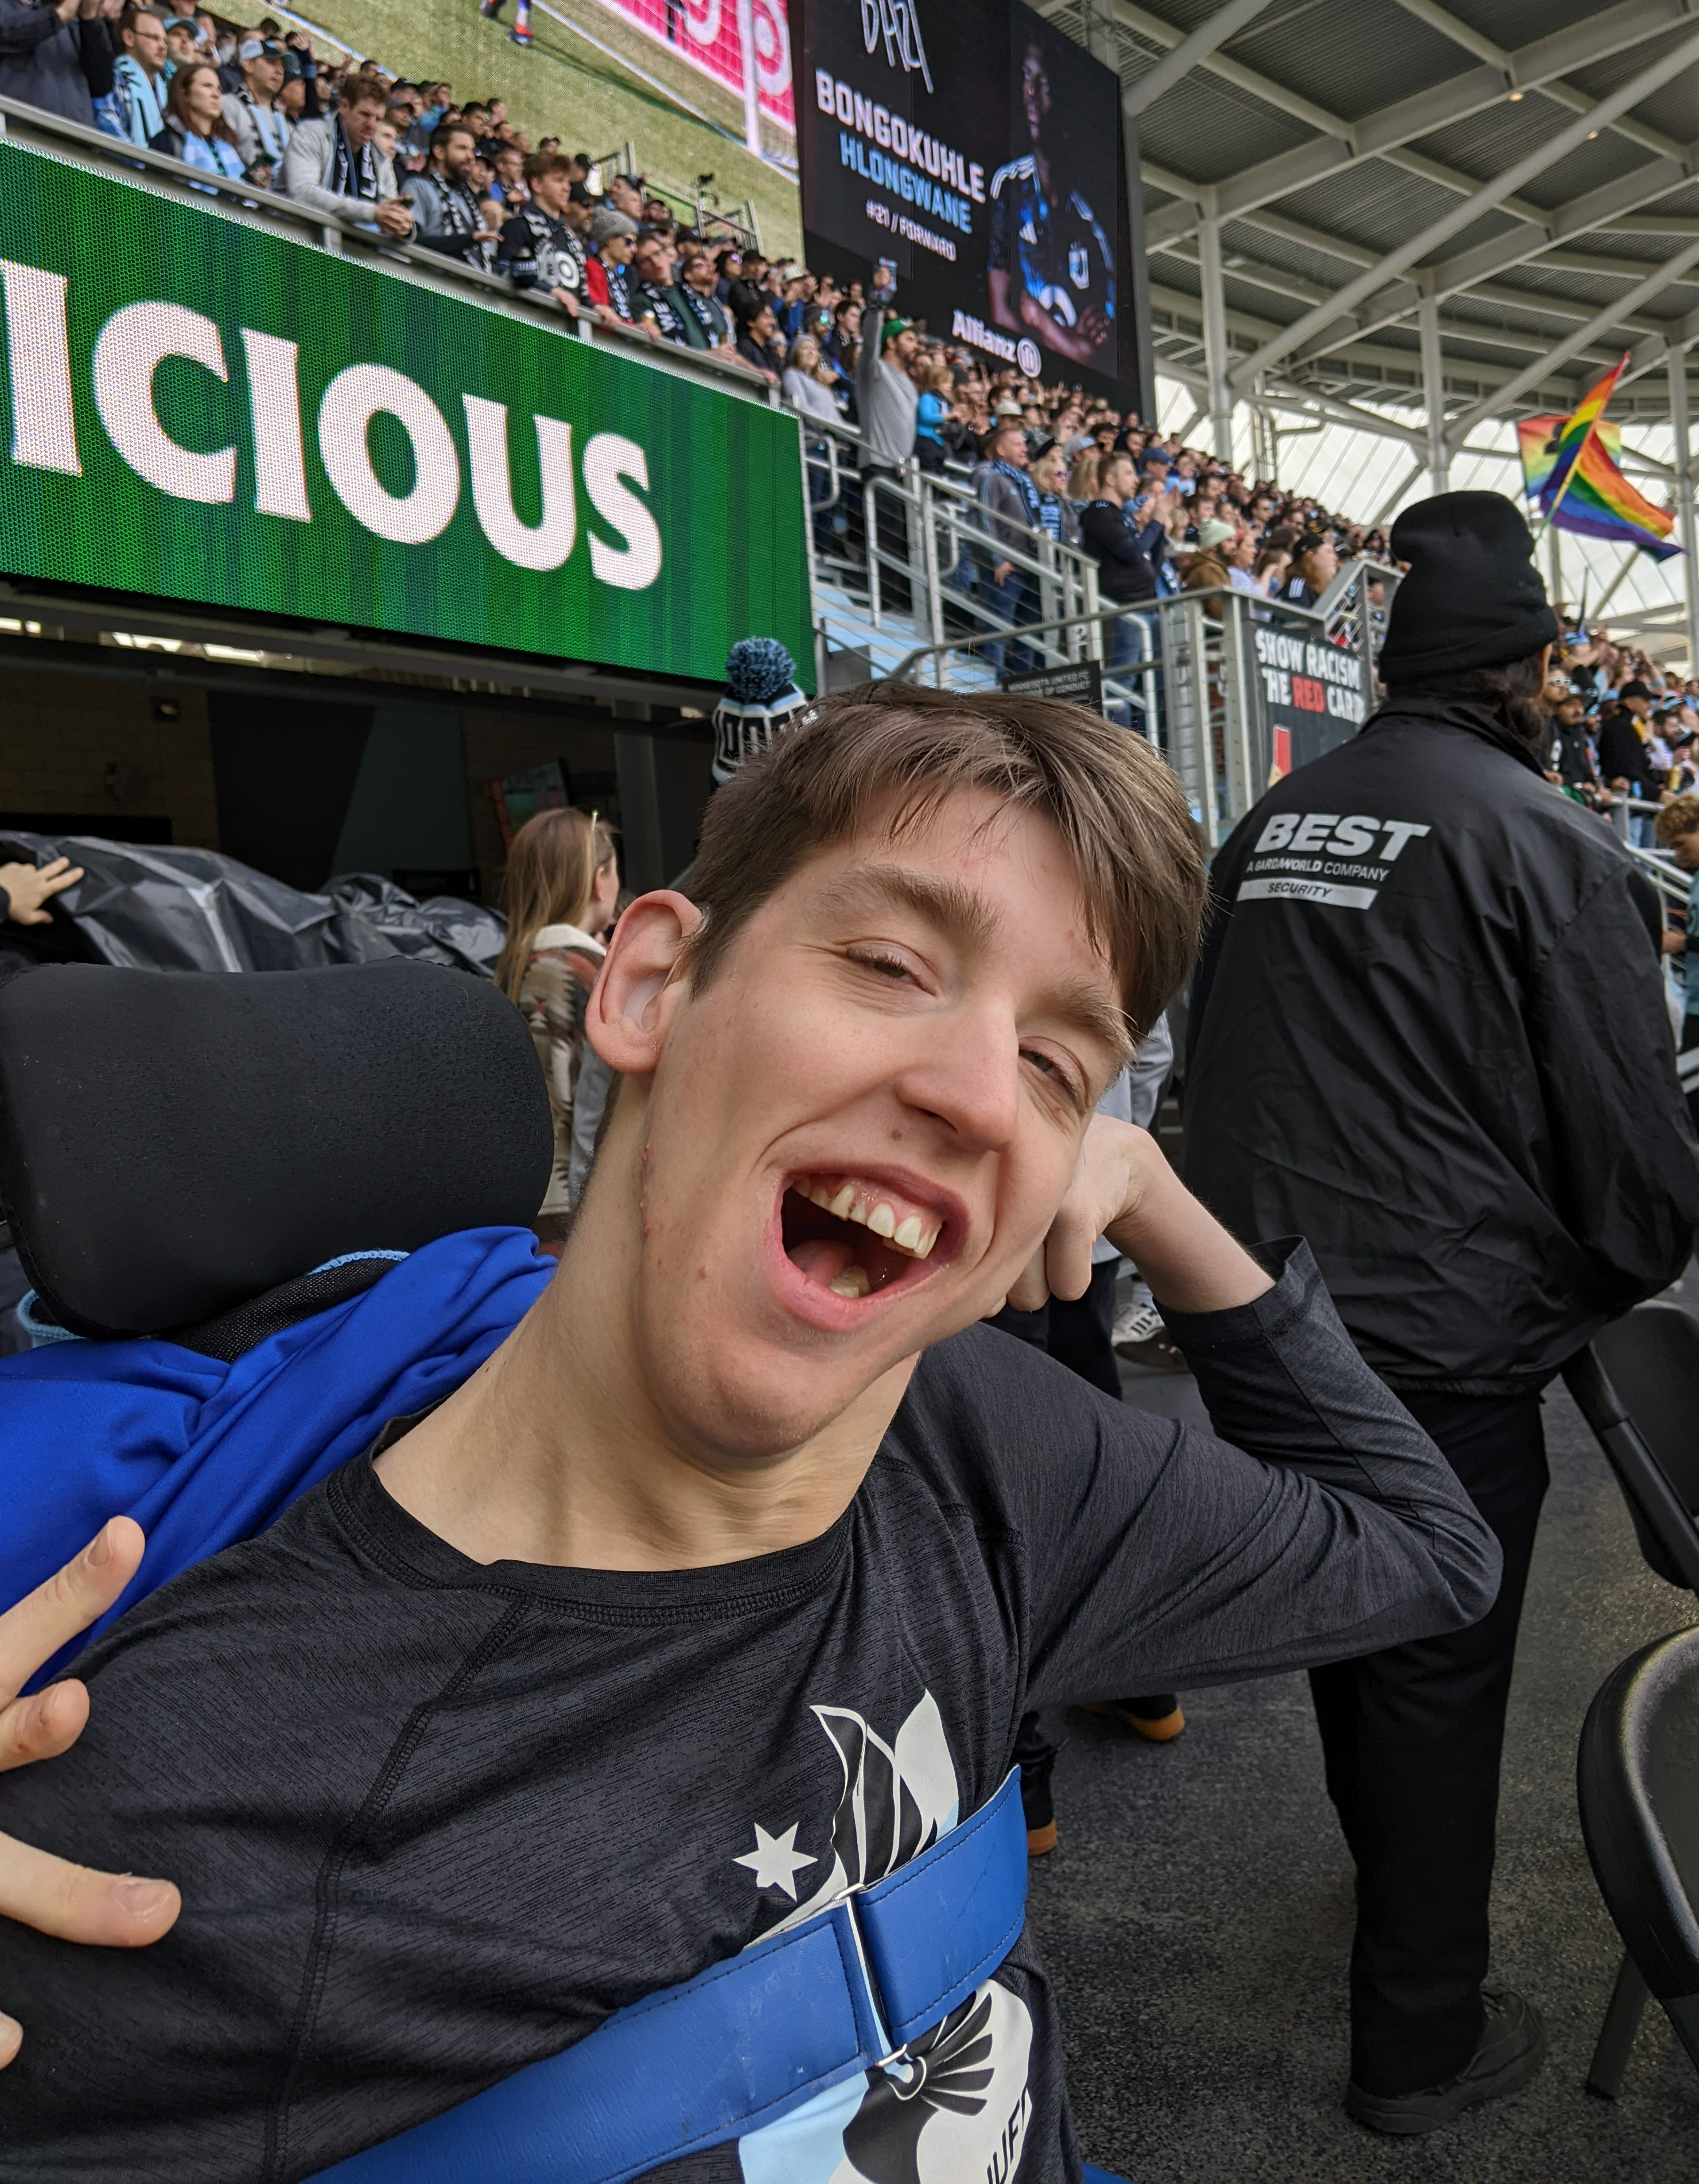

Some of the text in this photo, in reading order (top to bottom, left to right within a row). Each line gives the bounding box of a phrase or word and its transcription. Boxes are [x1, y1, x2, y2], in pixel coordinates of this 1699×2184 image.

[815, 67, 986, 204] BONGOKUHLE
[839, 131, 973, 235] HLONGWANE
[899, 215, 957, 262] FORWARD
[952, 309, 1017, 363] Allianz
[1, 258, 663, 591] ICIOUS
[1255, 628, 1360, 691] SHOW RACISM
[1292, 674, 1326, 713] RED
[1327, 684, 1366, 725] CARD
[1254, 813, 1432, 861] BEST
[1246, 857, 1391, 882] A GARDAWORLD COMPANY
[1268, 882, 1332, 898] SECURITY
